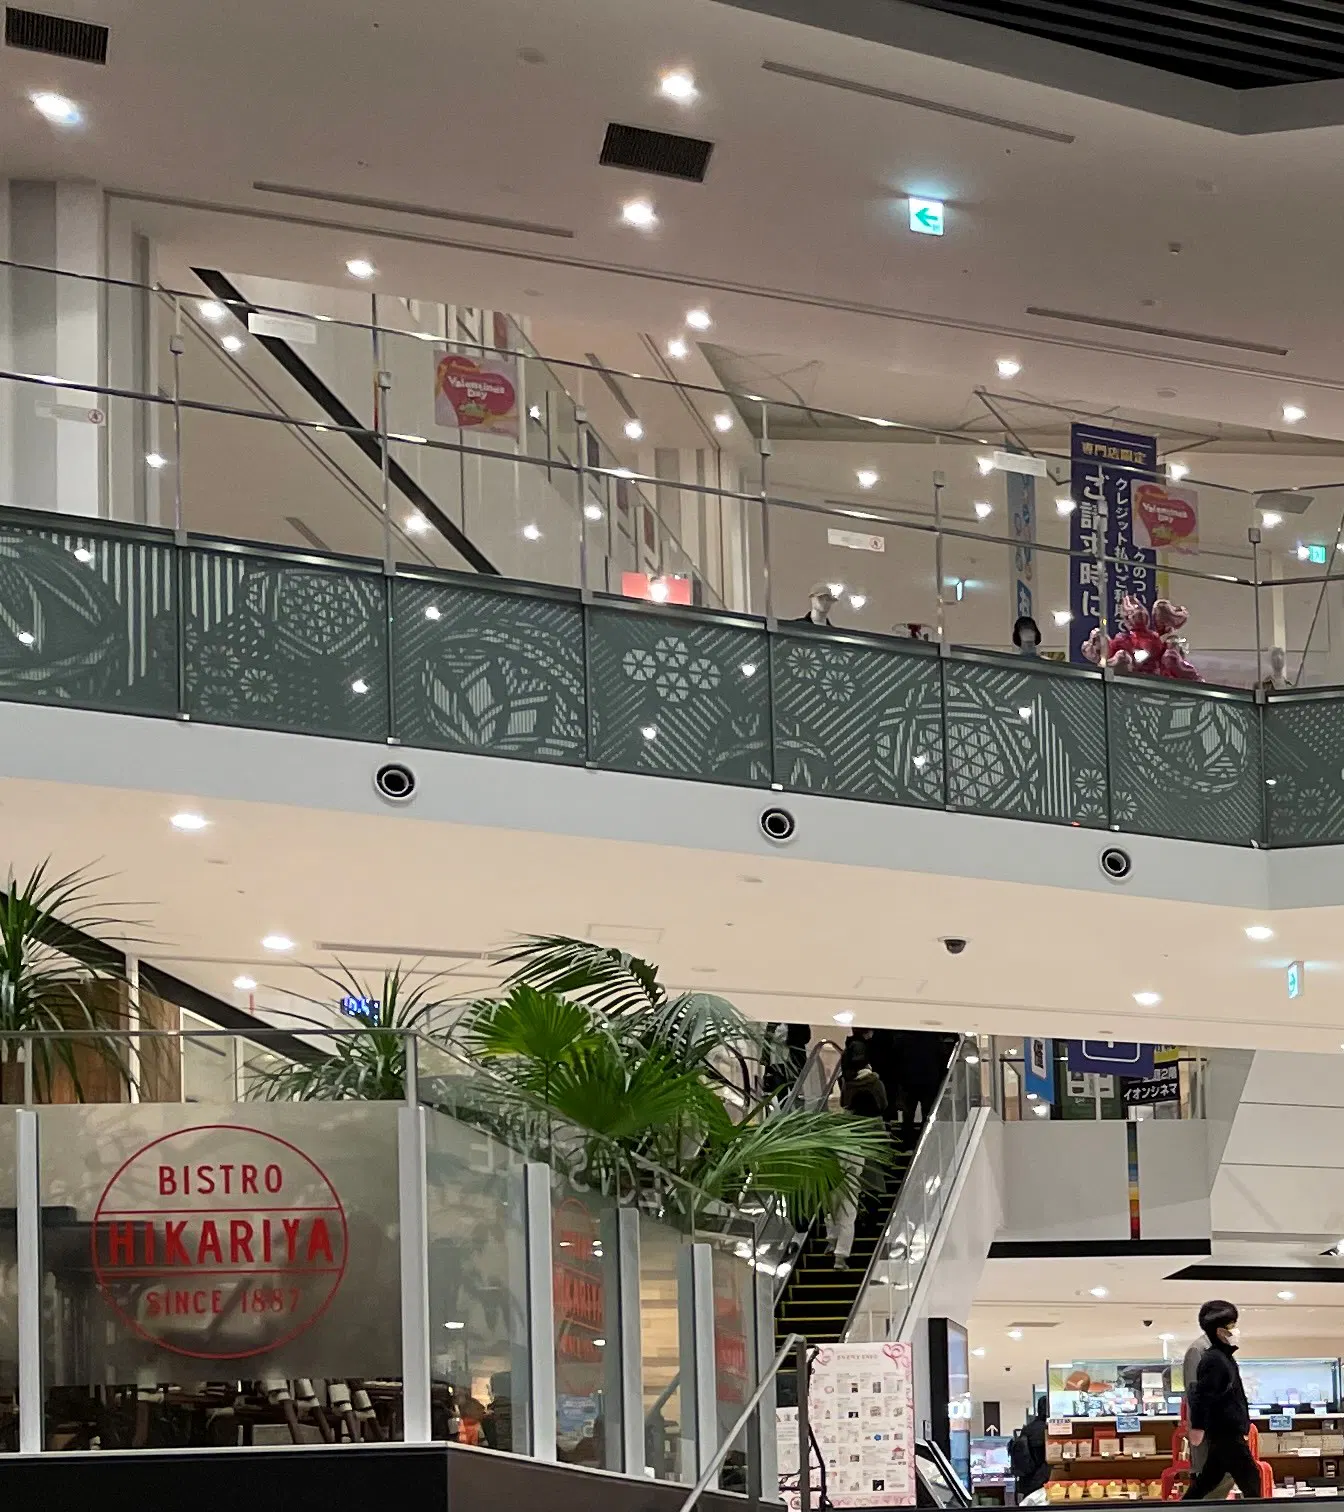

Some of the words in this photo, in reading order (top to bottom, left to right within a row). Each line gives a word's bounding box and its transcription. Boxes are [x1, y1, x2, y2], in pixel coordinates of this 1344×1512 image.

[467, 388, 488, 400] Day
[1157, 512, 1174, 524] Day
[1123, 1083, 1178, 1101] イオンシネマ
[158, 1164, 283, 1195] BISTRO
[108, 1218, 335, 1265] HIKARIYA
[145, 1288, 223, 1316] SINCE
[241, 1287, 301, 1314] 1887
